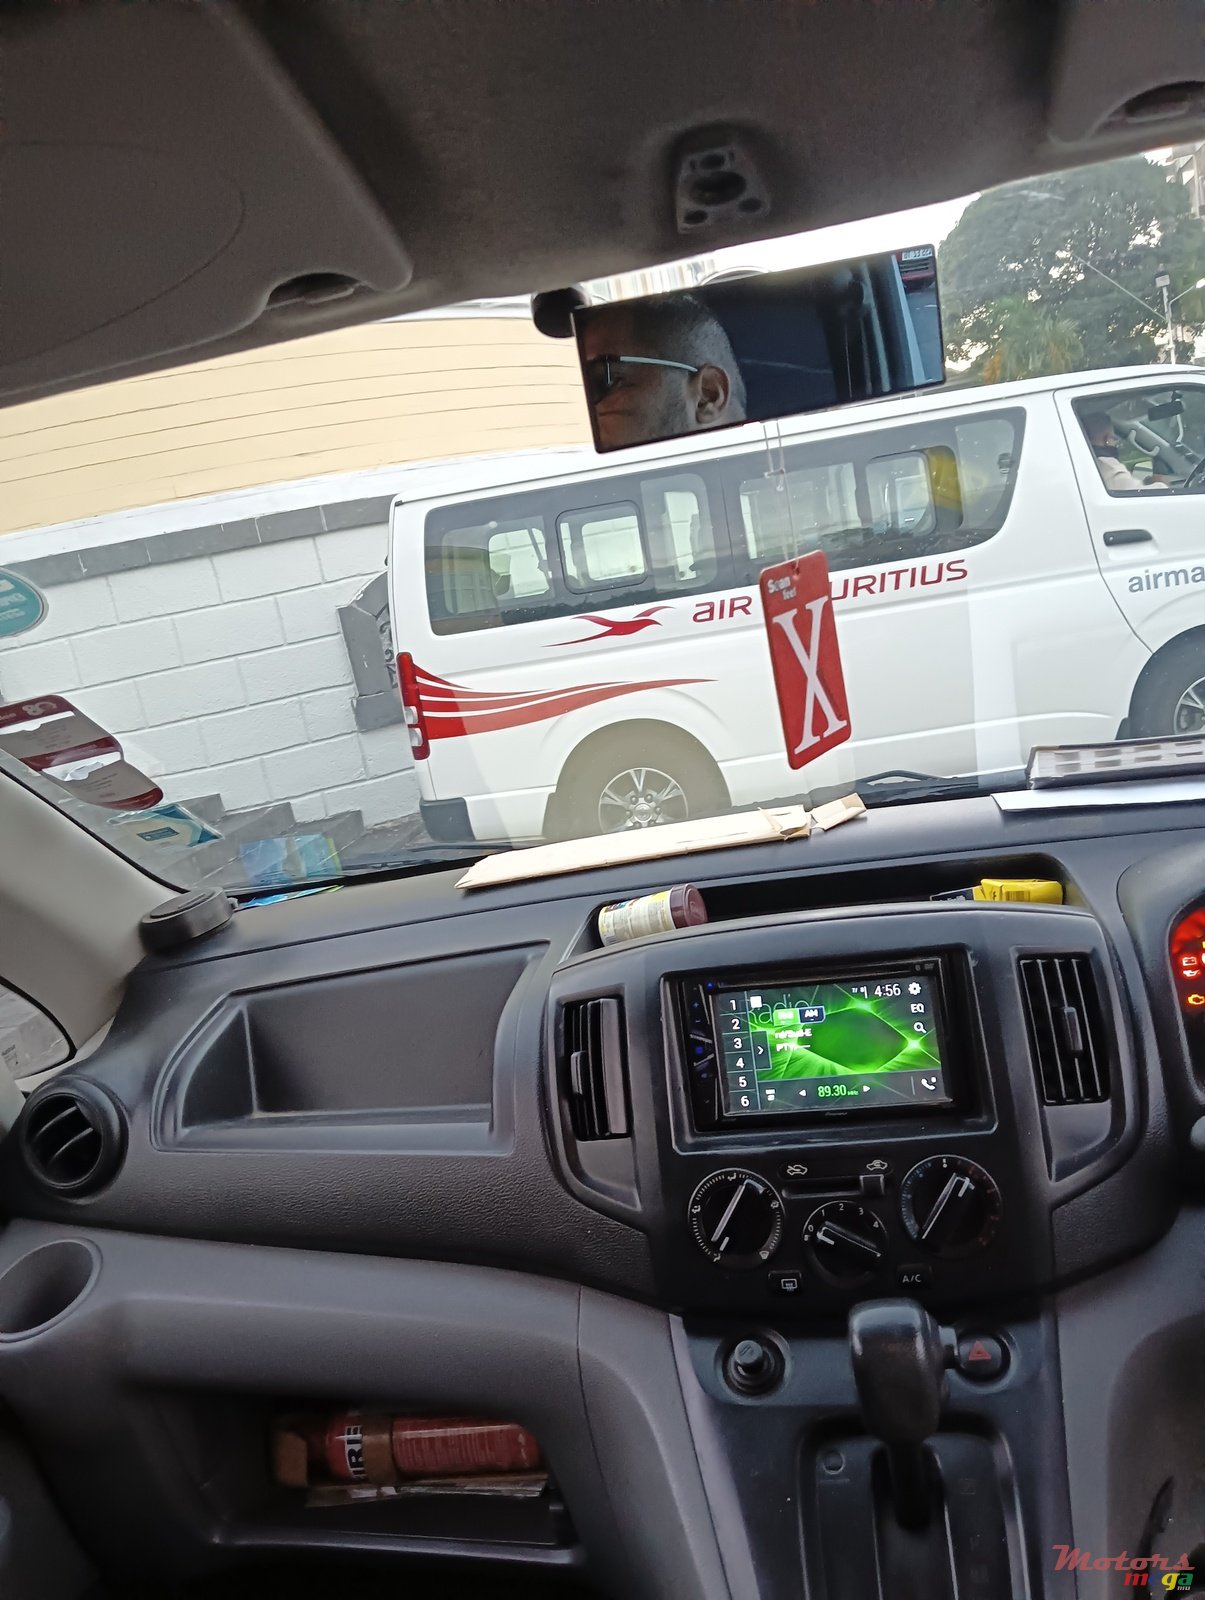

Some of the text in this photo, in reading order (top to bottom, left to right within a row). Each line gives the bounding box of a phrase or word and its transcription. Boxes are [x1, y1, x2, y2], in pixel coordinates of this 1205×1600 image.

[829, 559, 968, 600] URITIUS
[772, 595, 847, 755] X
[874, 983, 901, 997] 4:56
[730, 999, 737, 1011] 1
[910, 1003, 925, 1014] EQ
[731, 1018, 741, 1030] 2
[733, 1037, 743, 1049] 3
[735, 1057, 745, 1069] 4
[738, 1076, 748, 1088] 5
[817, 1084, 847, 1098] 89.30
[740, 1095, 750, 1107] 6
[839, 1203, 845, 1211] 2
[859, 1207, 864, 1215] 3
[873, 1220, 879, 1228] 4
[902, 1274, 922, 1283] A/C
